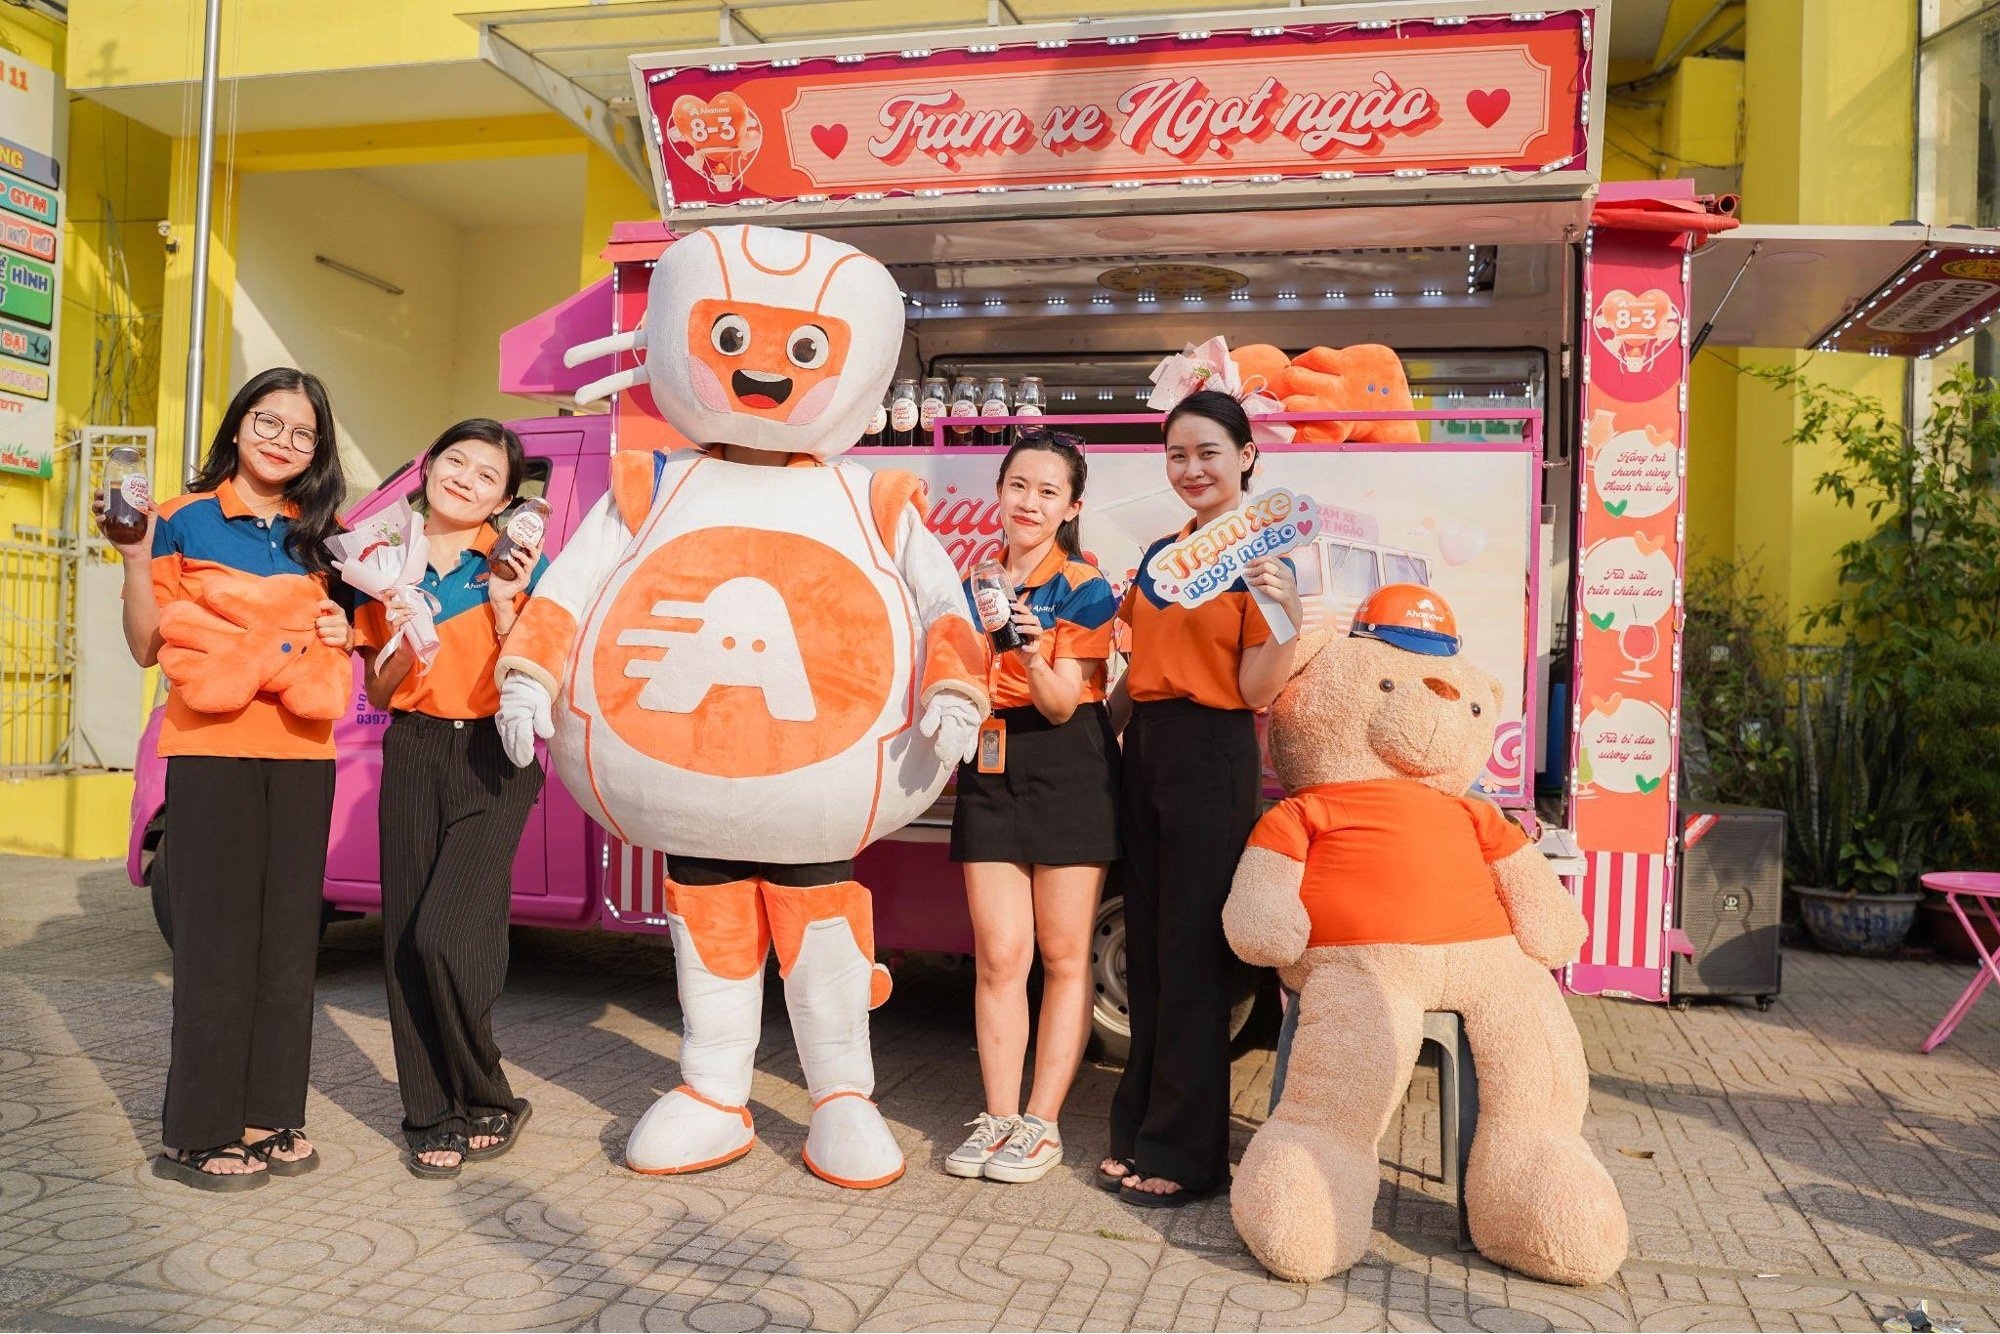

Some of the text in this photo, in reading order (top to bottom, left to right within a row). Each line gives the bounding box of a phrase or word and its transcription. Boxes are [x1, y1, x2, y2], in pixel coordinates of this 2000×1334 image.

[690, 116, 736, 143] 8-3
[868, 71, 1436, 170] Trạm xe Ngọt ngào
[10, 187, 48, 214] GYM
[12, 266, 48, 292] HÌNH
[1615, 309, 1657, 330] 8-3
[1155, 491, 1293, 580] Trạm xe
[1183, 522, 1297, 600] ngọt ngào
